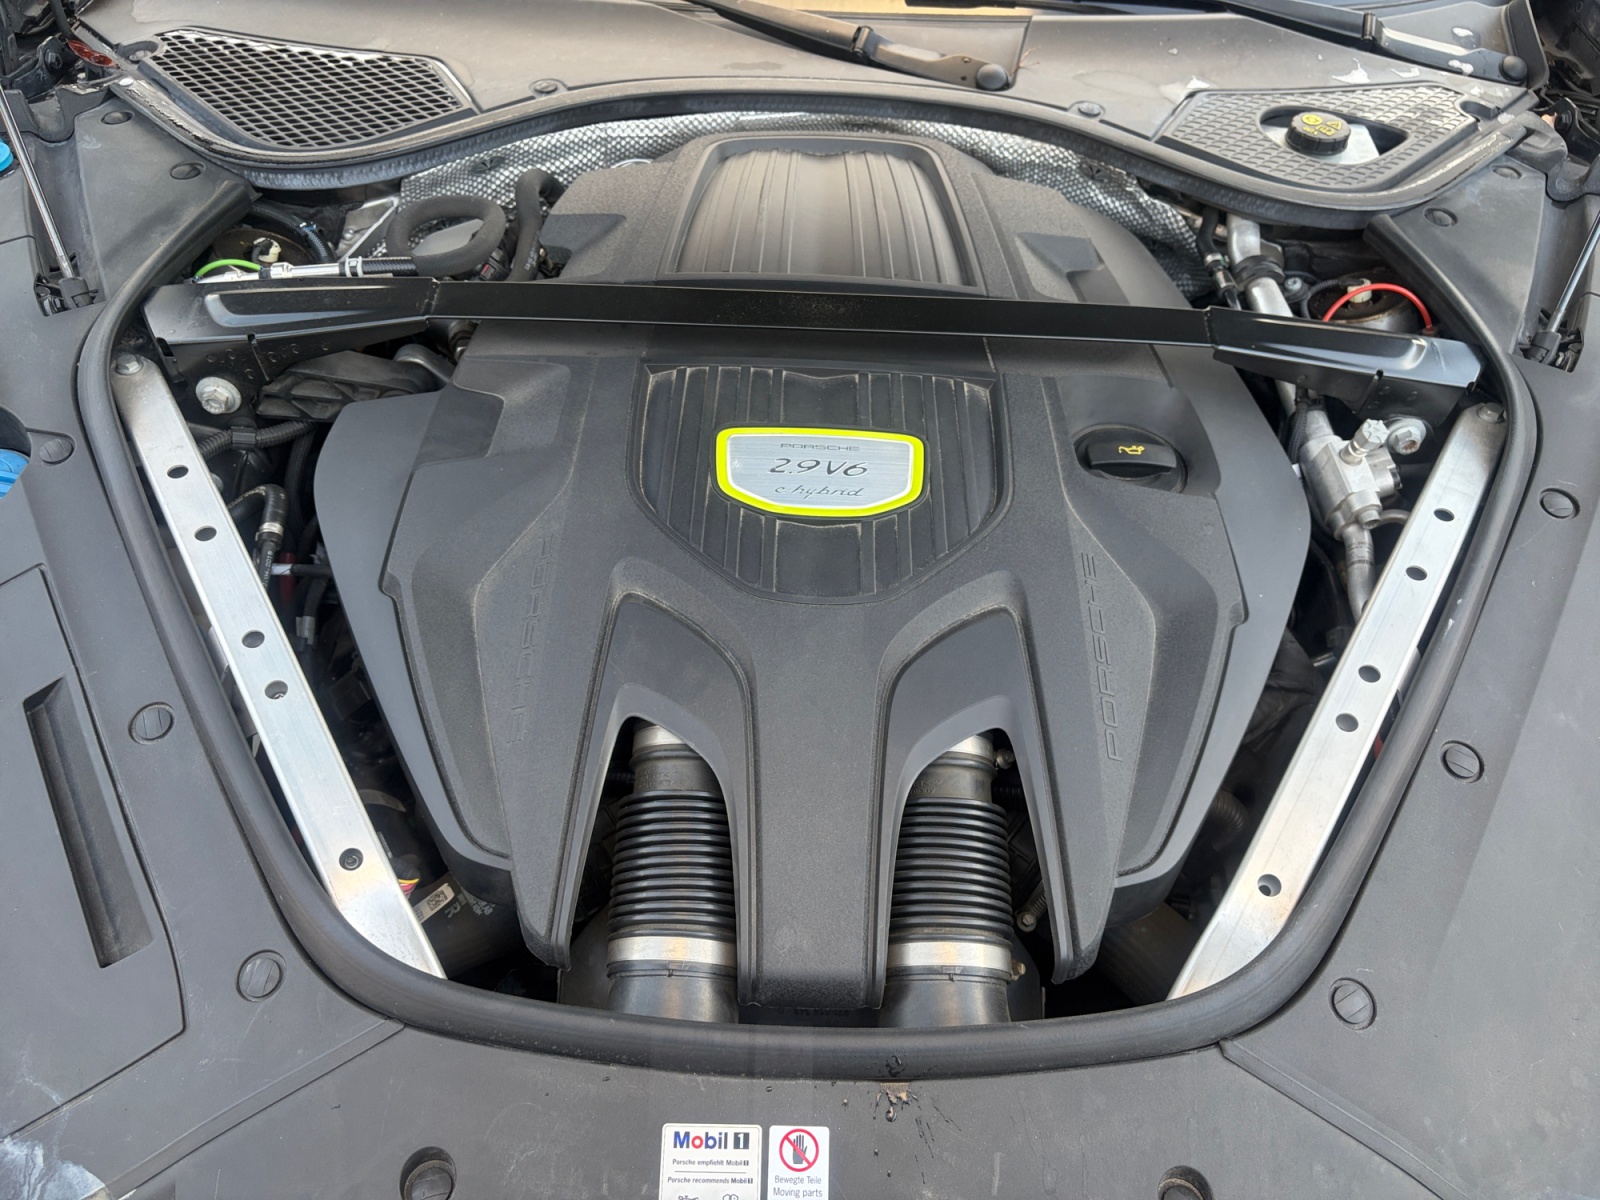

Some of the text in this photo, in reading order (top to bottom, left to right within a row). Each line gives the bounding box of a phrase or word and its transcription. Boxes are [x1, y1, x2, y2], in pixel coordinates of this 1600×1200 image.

[780, 443, 860, 451] PORSCHE
[769, 458, 868, 477] 2.9 V6
[1081, 552, 1124, 762] PORSCHE
[673, 1131, 728, 1150] Mobil
[667, 1176, 691, 1184] Porsche
[774, 1175, 822, 1185] Bewegte Teile
[773, 1187, 823, 1199] Moving parts
